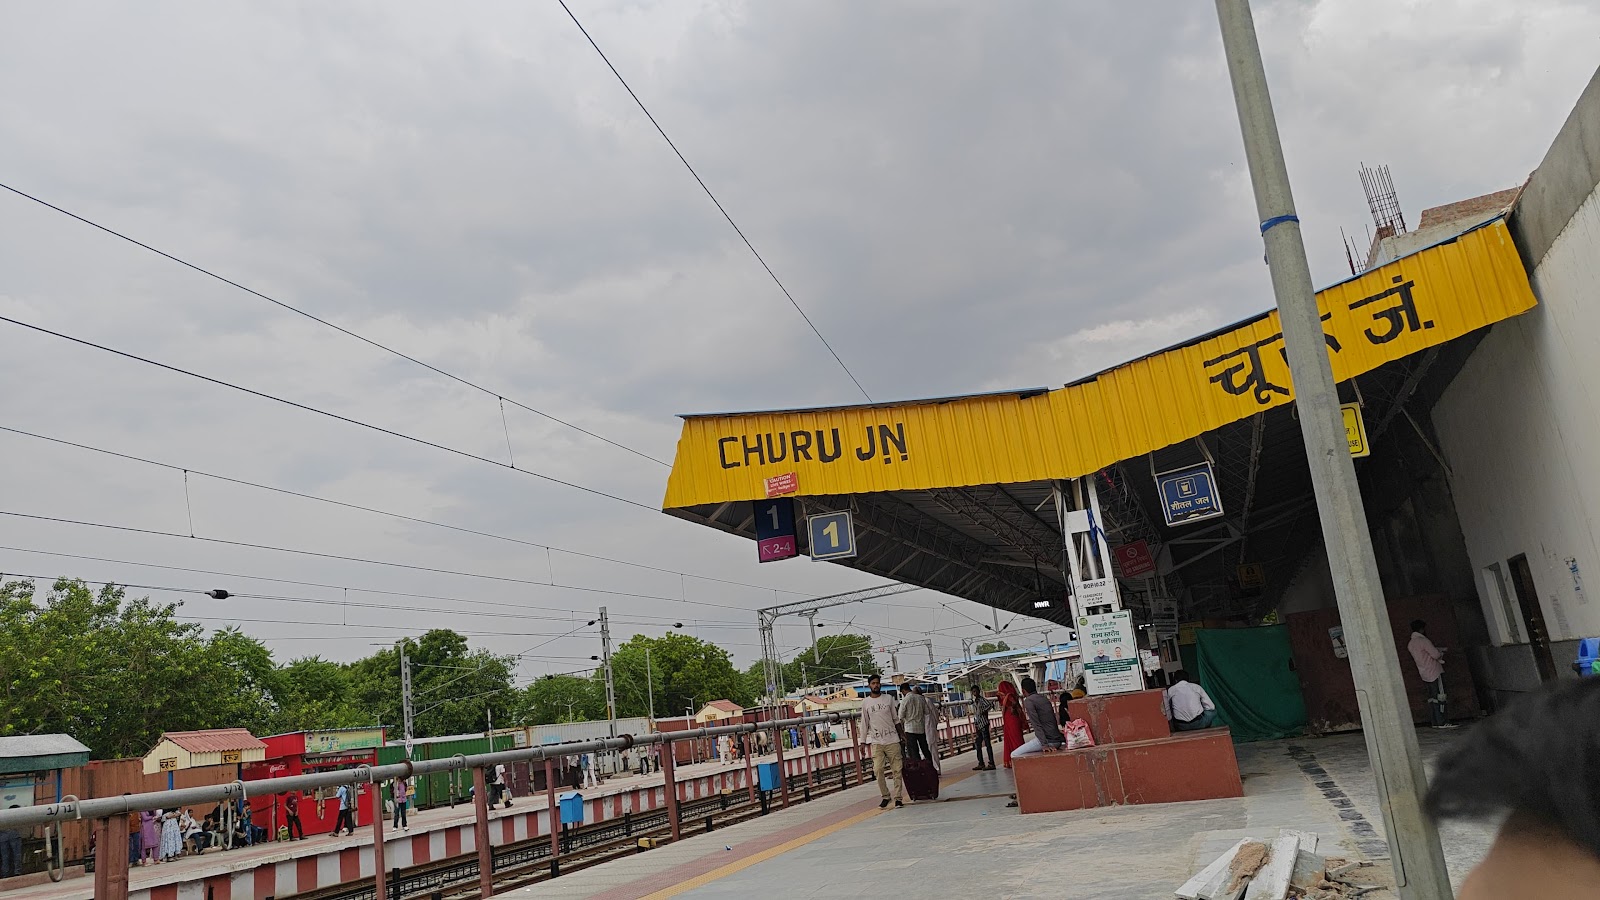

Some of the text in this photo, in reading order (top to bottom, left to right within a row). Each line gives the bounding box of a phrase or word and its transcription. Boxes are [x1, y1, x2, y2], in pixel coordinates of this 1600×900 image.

[1348, 275, 1434, 345] जं.
[717, 427, 842, 470] CHURU
[769, 474, 791, 484] CAUTION
[1170, 500, 1192, 511] शीतल
[1195, 496, 1210, 505] जल
[767, 504, 780, 531] 1
[822, 520, 840, 548] 1
[772, 543, 791, 554] 2-4
